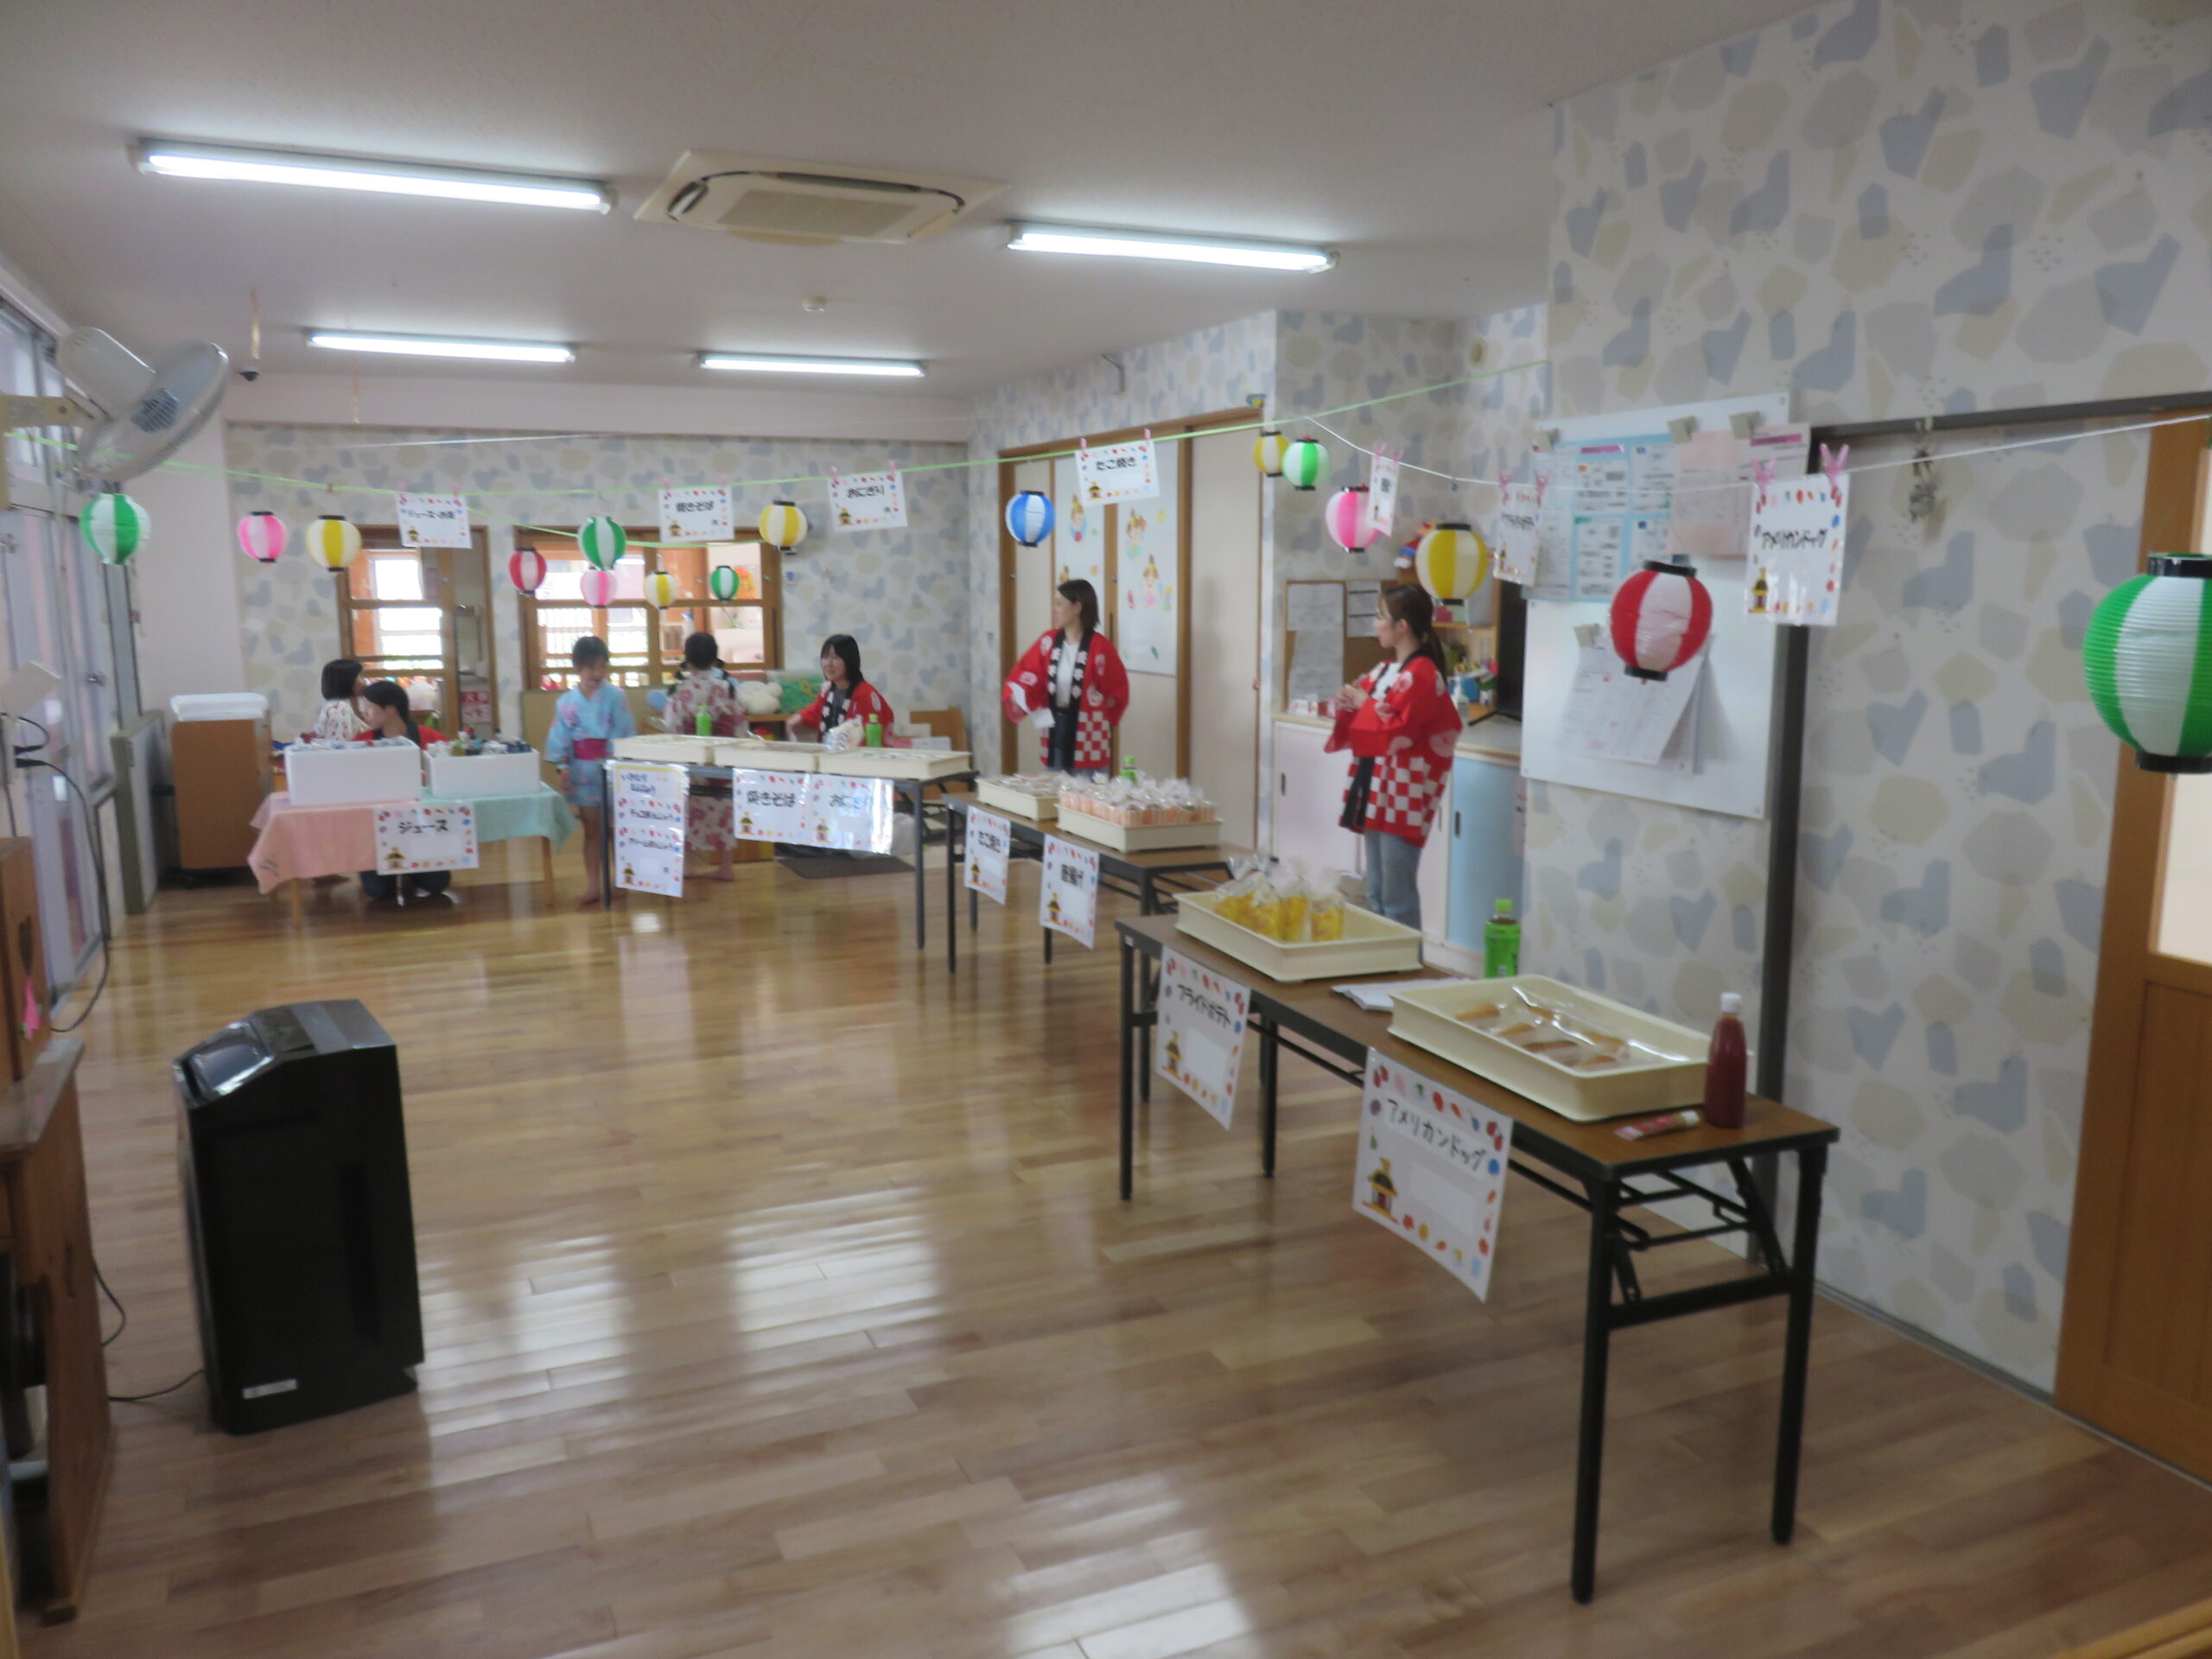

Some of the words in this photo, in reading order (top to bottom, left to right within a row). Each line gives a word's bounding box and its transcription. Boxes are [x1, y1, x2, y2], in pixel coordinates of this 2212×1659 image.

[848, 485, 885, 499] おにぎり
[677, 501, 714, 512] 焼きそば
[747, 790, 796, 808] 焼きそば
[398, 819, 449, 835] ジュース
[1386, 1097, 1487, 1171] アメリカンドッグ
